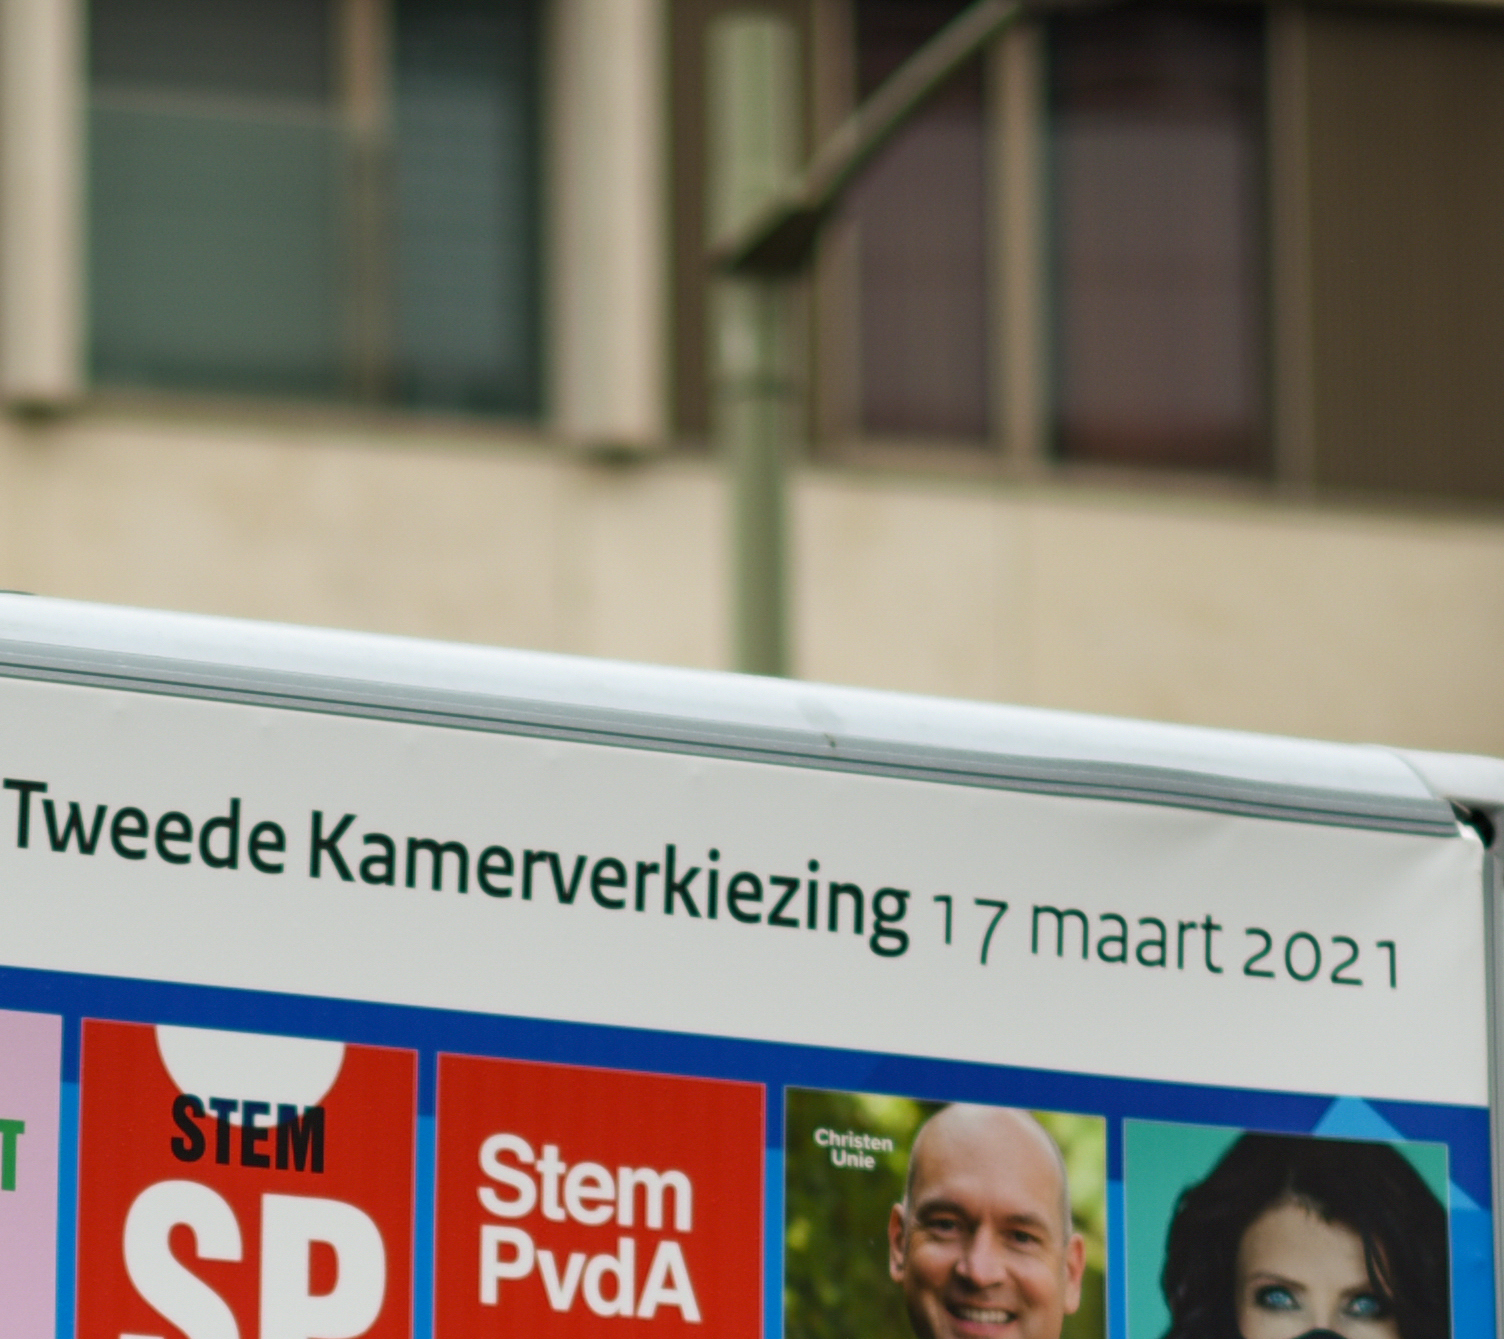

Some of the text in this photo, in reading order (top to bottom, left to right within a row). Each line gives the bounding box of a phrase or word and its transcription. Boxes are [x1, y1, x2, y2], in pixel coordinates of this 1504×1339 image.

[3, 778, 1398, 989] Tweede Kamerverkiezing 17 maart 2021
[170, 1092, 326, 1173] STEM
[476, 1132, 693, 1233] Stem
[479, 1224, 703, 1323] PvdA
